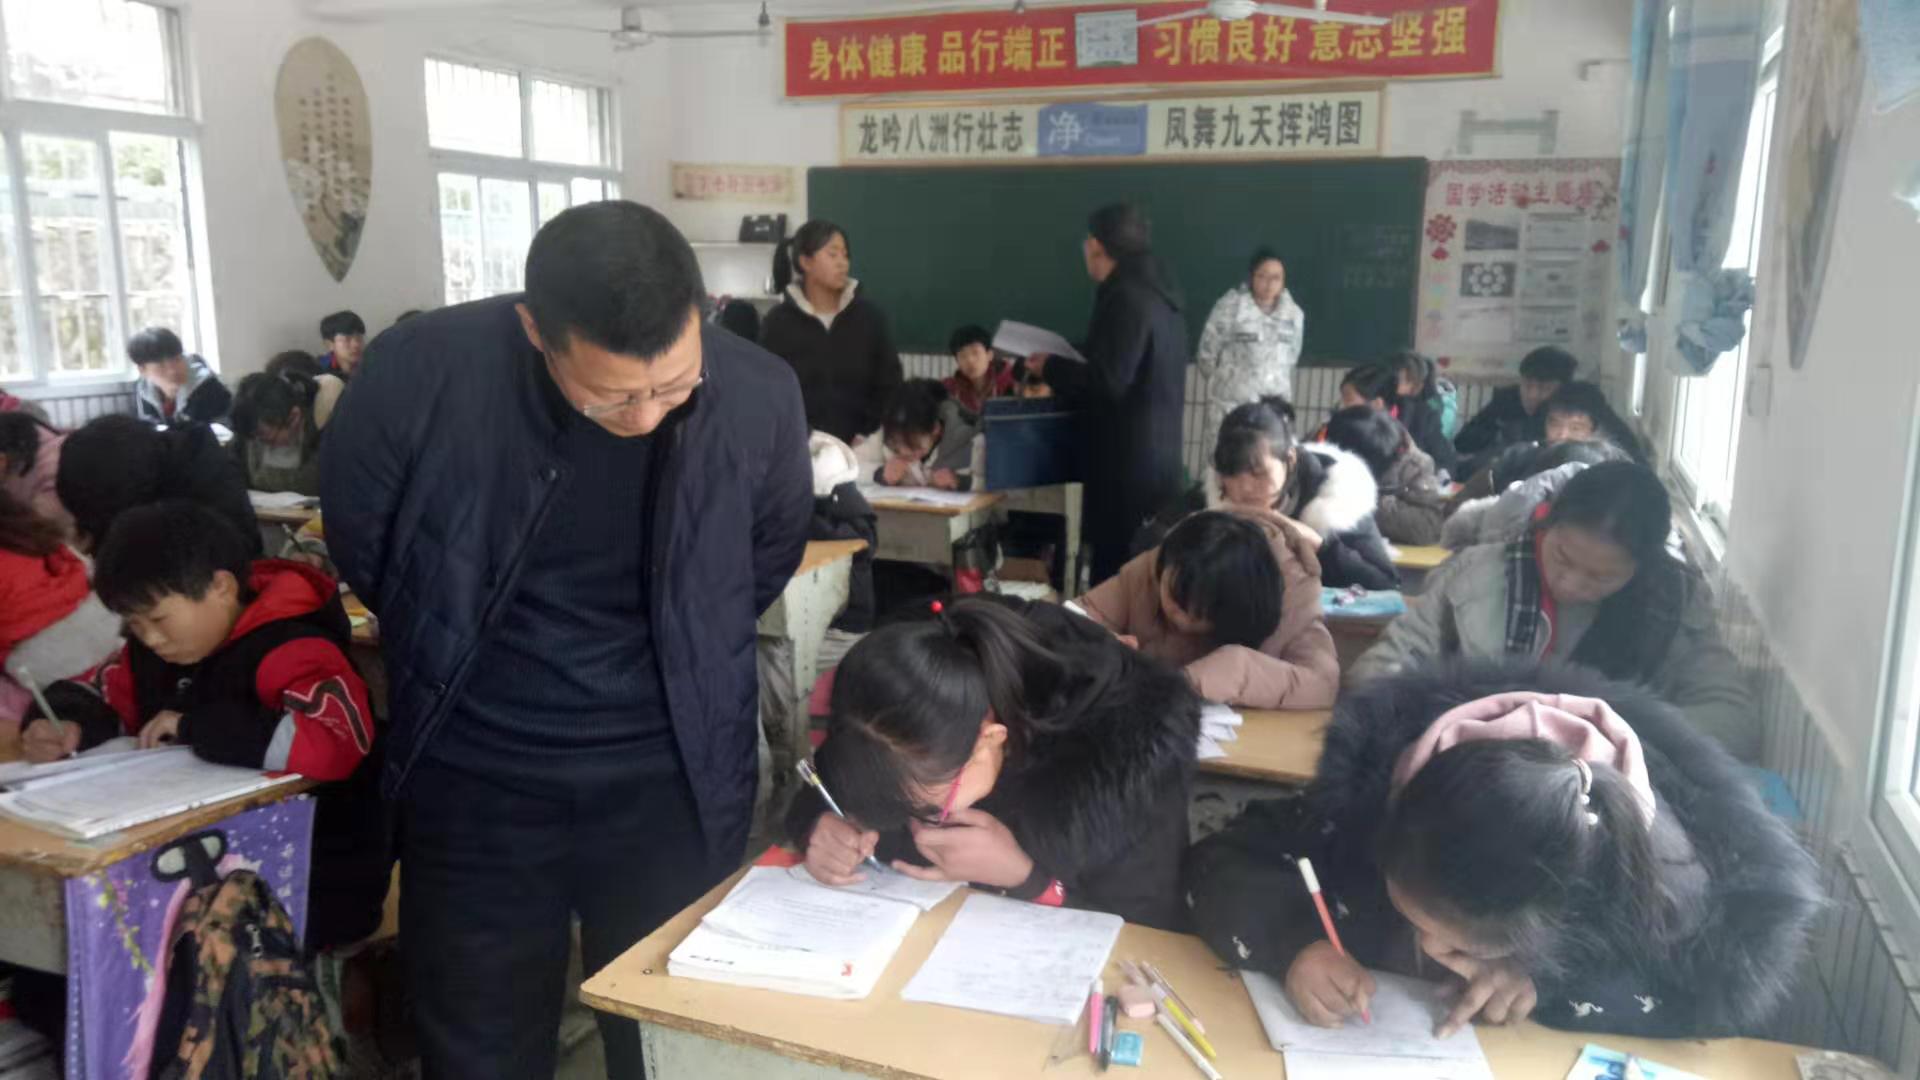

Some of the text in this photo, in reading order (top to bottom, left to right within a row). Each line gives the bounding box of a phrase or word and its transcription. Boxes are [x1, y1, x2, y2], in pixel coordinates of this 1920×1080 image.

[809, 32, 927, 80] 身体健康
[938, 26, 1067, 74] 品行端正
[1153, 16, 1297, 65] 习惯良好
[1310, 7, 1468, 61] 意志坚强
[859, 110, 1023, 154] 龙吟八洲行壮志
[1048, 111, 1083, 150] 净
[1164, 101, 1362, 149] 凤舞九天挥鸿图
